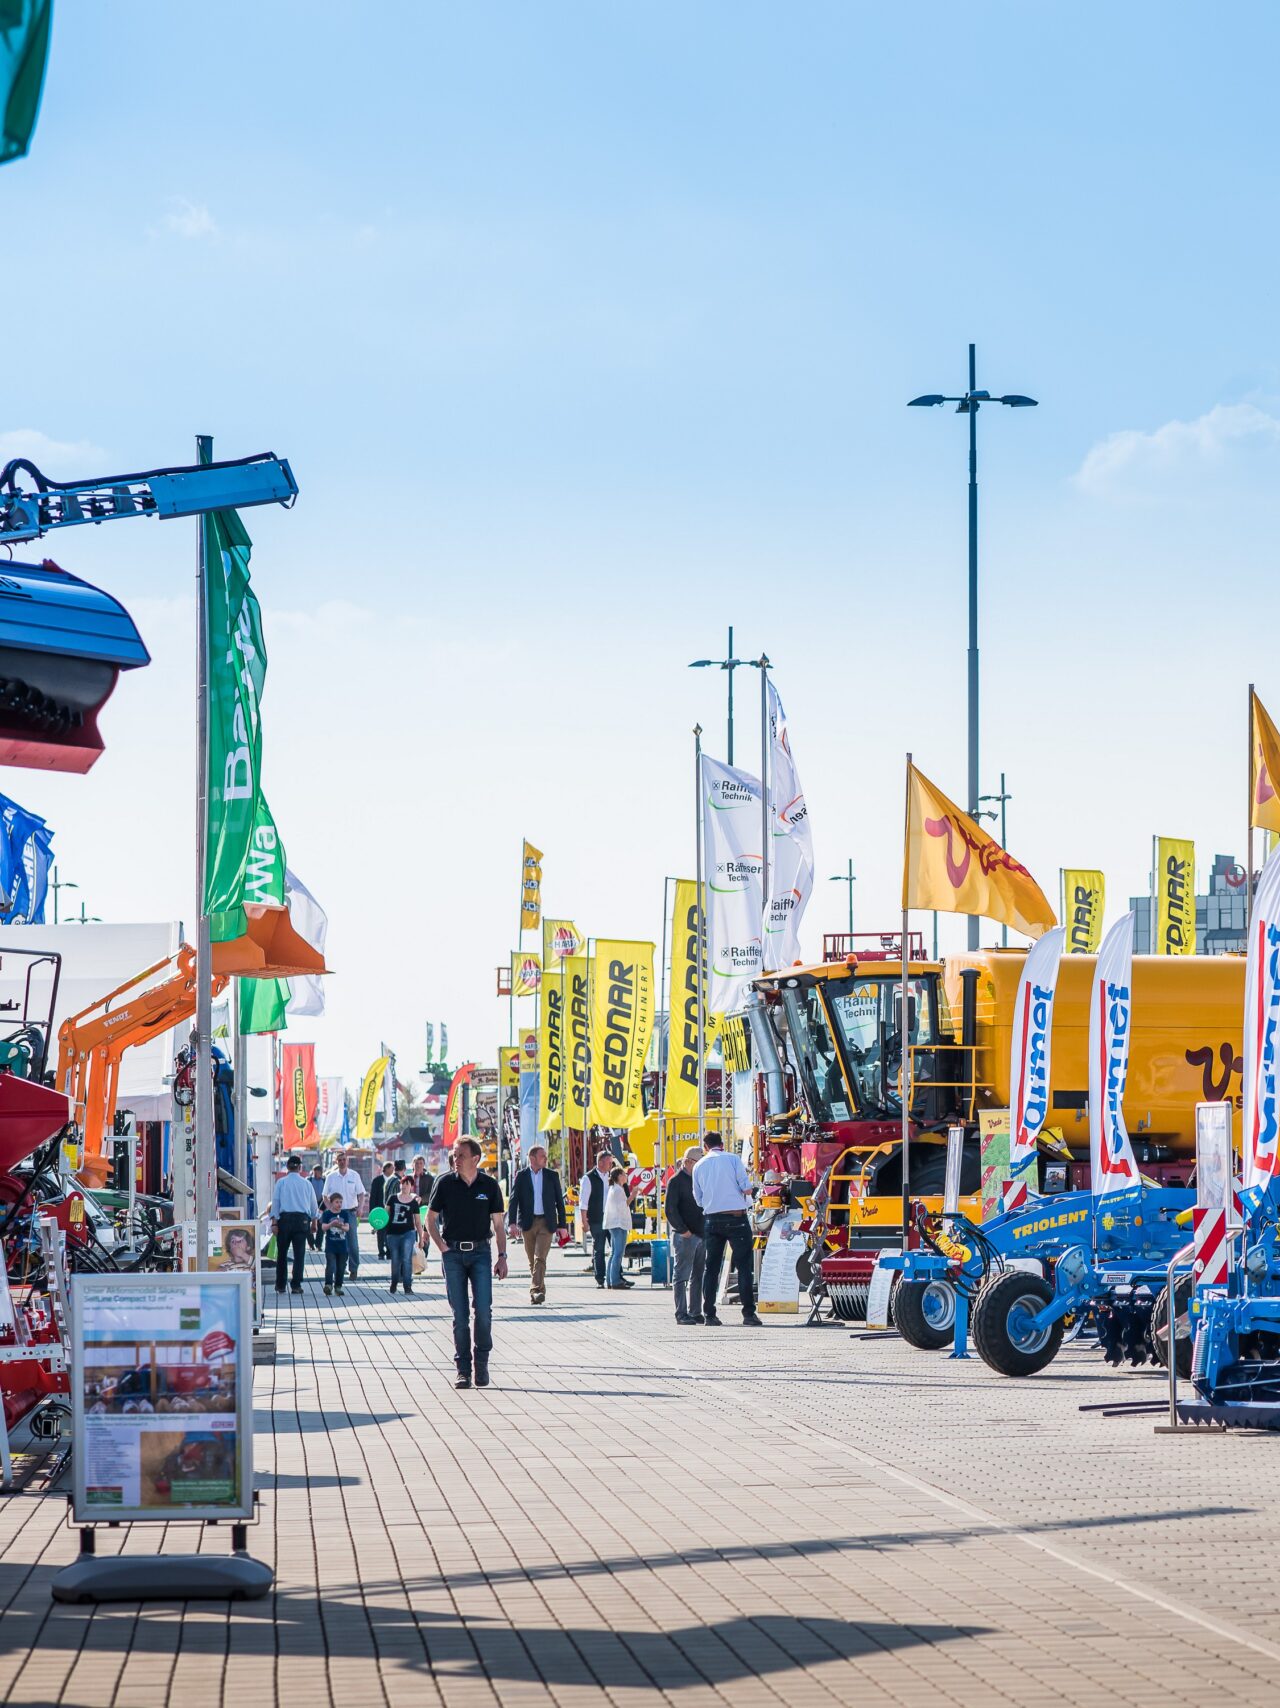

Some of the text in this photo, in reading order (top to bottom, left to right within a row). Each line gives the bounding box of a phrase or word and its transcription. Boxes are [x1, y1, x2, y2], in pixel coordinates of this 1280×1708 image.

[721, 792, 752, 802] Technik
[603, 960, 634, 1106] BEDNAR
[630, 965, 649, 1109] FARM MACHINERY
[642, 1172, 651, 1180] 20
[392, 1203, 411, 1224] E
[861, 1203, 879, 1218] Vredo
[1012, 1209, 1088, 1240] TRIOLENT
